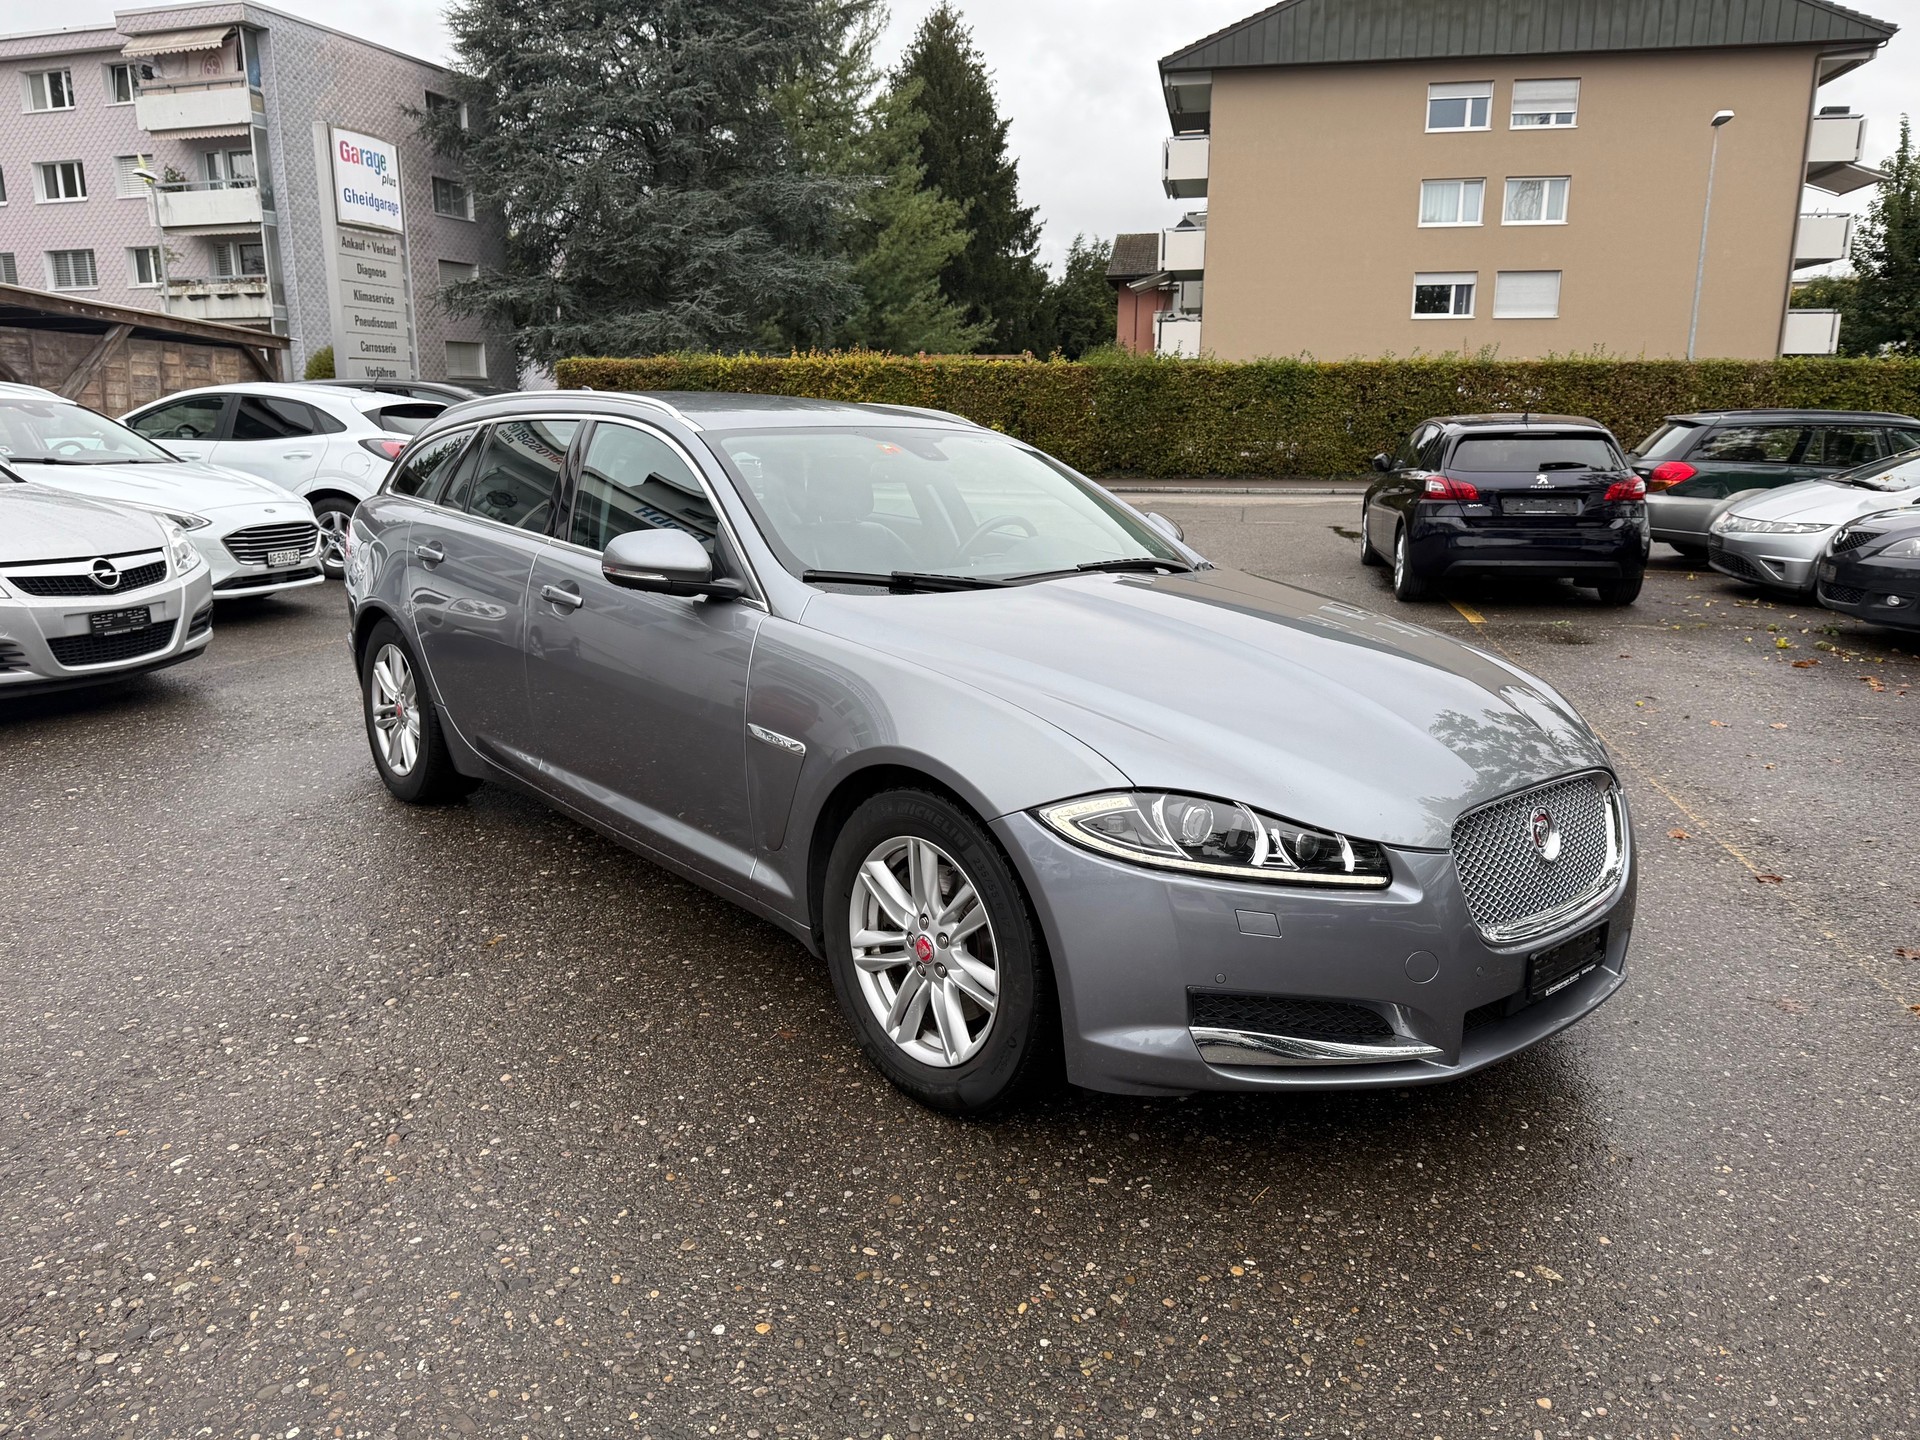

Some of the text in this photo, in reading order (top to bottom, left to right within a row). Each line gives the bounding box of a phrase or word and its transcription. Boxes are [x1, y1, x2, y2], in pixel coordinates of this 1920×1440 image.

[339, 140, 387, 175] Garage
[381, 173, 397, 187] plus
[343, 187, 399, 216] Gheidgarage
[341, 236, 365, 251] Ankauf
[372, 241, 397, 257] Verkauf
[356, 263, 387, 279] Diagnose
[353, 289, 395, 305] Klimaservice
[354, 314, 398, 330] Pneudiscount
[360, 340, 397, 354] Carrosserie
[896, 801, 969, 849] MICHELIN
